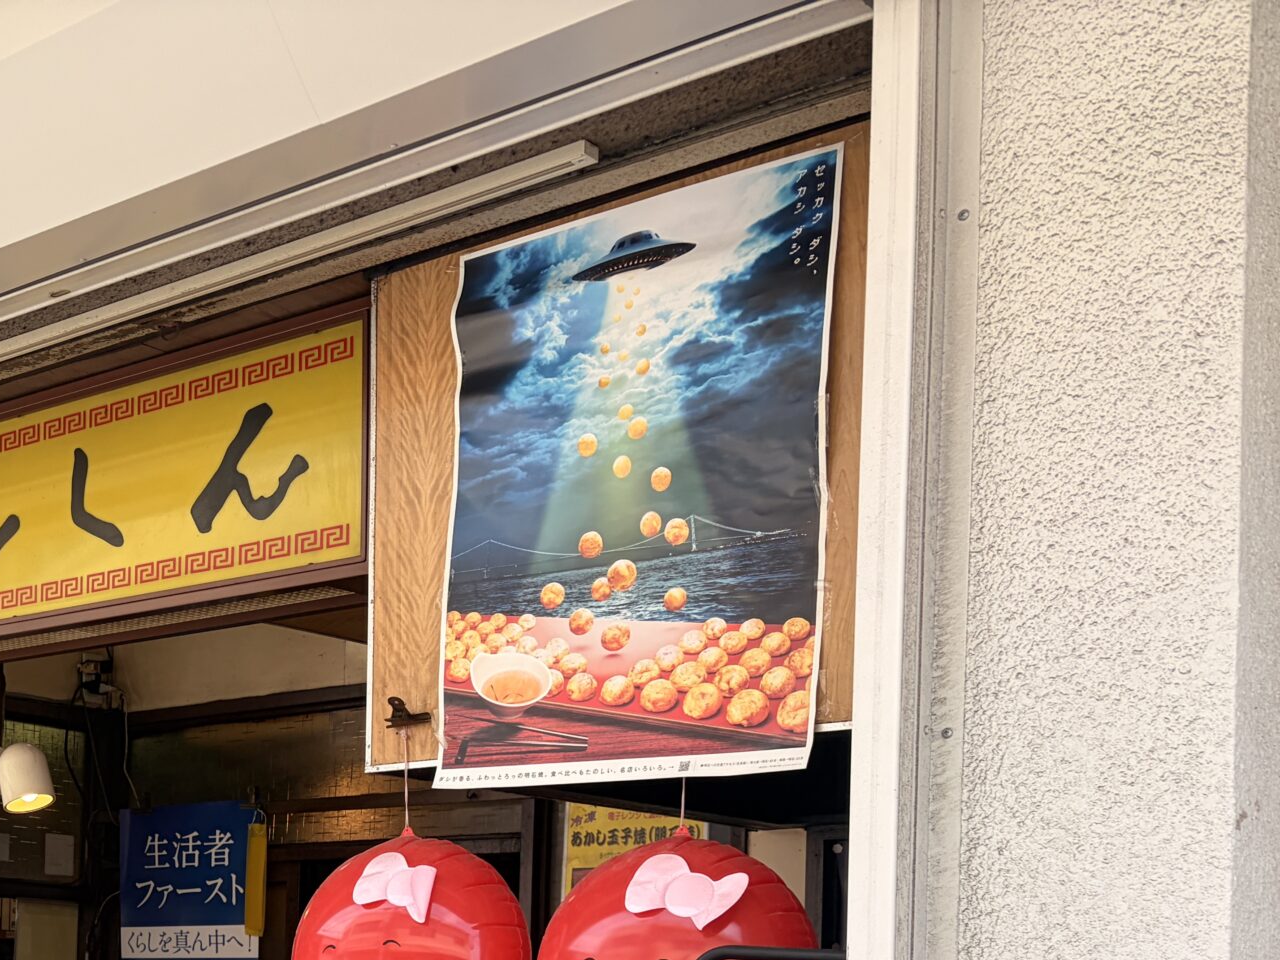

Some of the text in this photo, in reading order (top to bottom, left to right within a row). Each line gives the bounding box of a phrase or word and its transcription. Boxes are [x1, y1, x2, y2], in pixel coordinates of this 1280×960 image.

[143, 829, 235, 869] 生活者
[135, 873, 244, 909] ファースト
